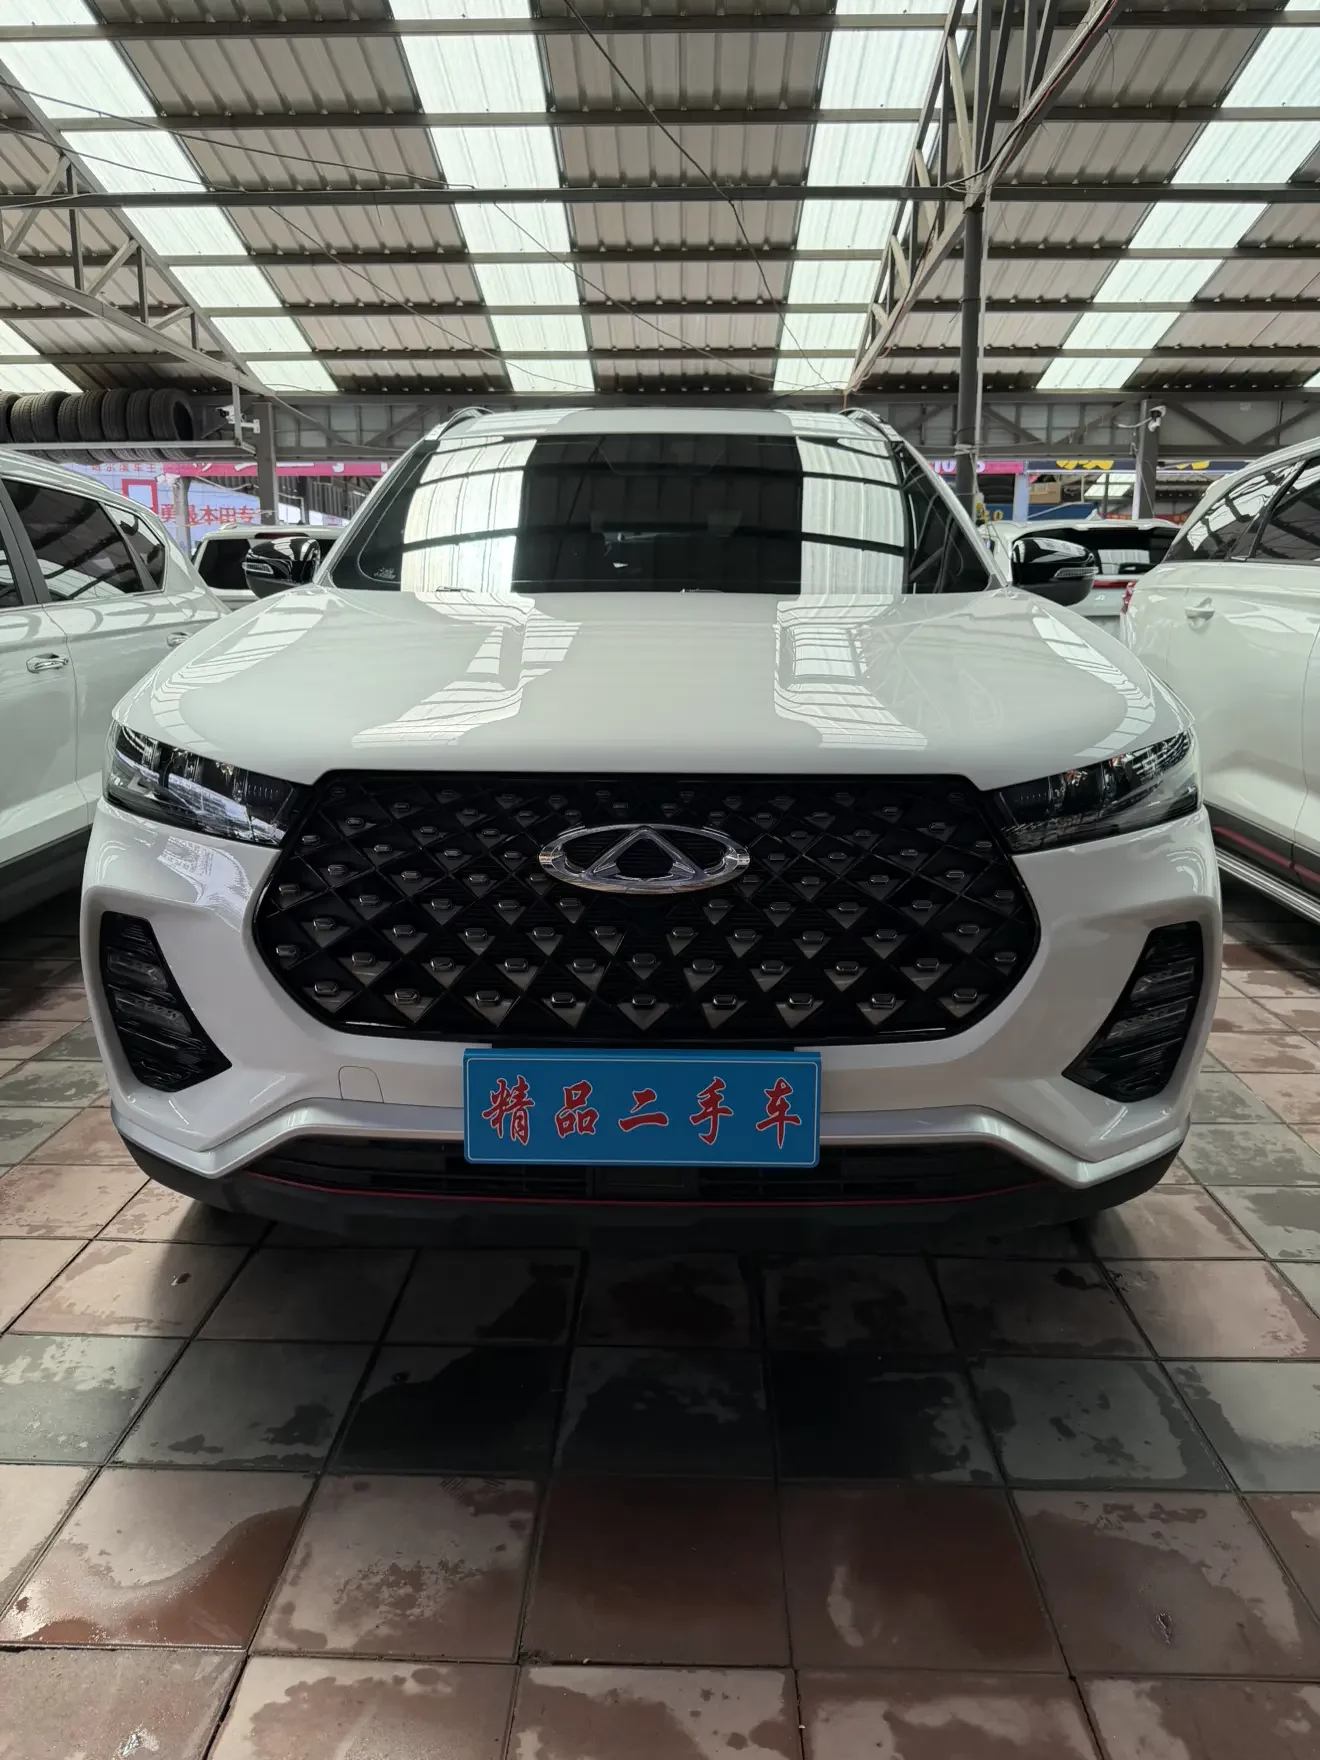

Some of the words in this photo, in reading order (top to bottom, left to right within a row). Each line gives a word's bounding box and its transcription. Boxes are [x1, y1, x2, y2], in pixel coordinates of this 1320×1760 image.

[481, 1075, 802, 1149] 精品二手车
